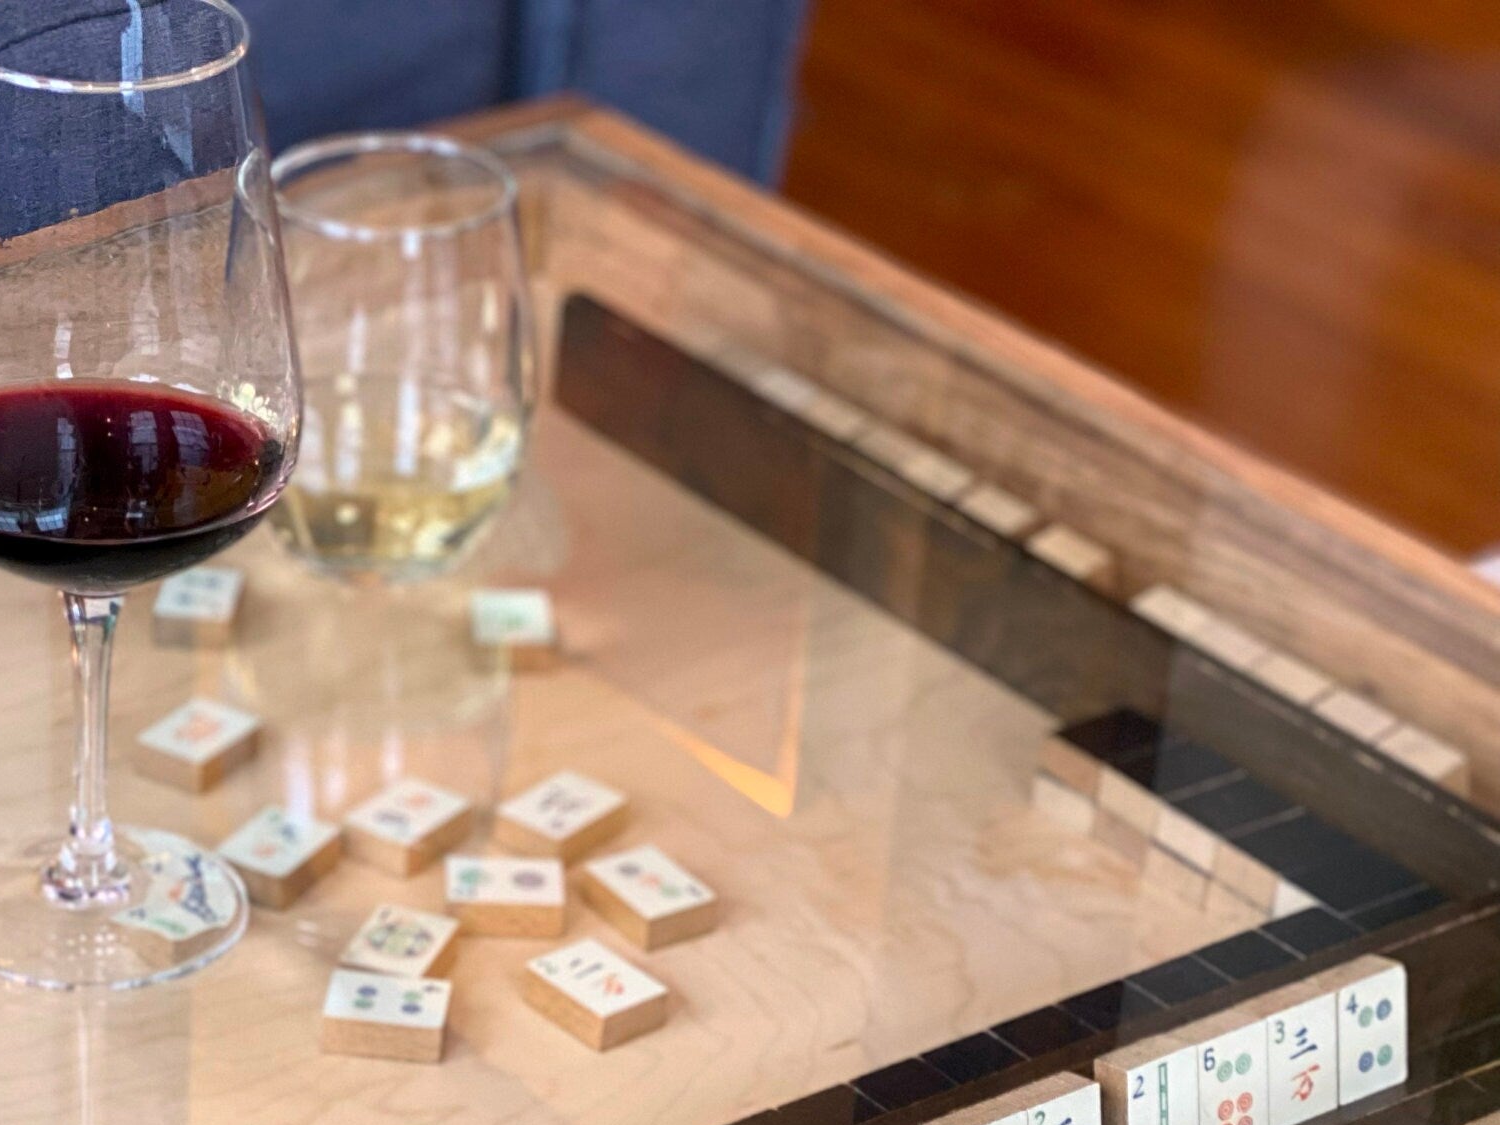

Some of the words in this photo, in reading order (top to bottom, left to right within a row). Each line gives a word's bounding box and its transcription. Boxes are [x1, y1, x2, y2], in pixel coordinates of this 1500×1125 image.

[1345, 993, 1359, 1016] 4
[1273, 1019, 1286, 1045] 3
[1289, 1027, 1319, 1060] 三
[1202, 1047, 1216, 1072] 6
[1132, 1074, 1146, 1100] 2
